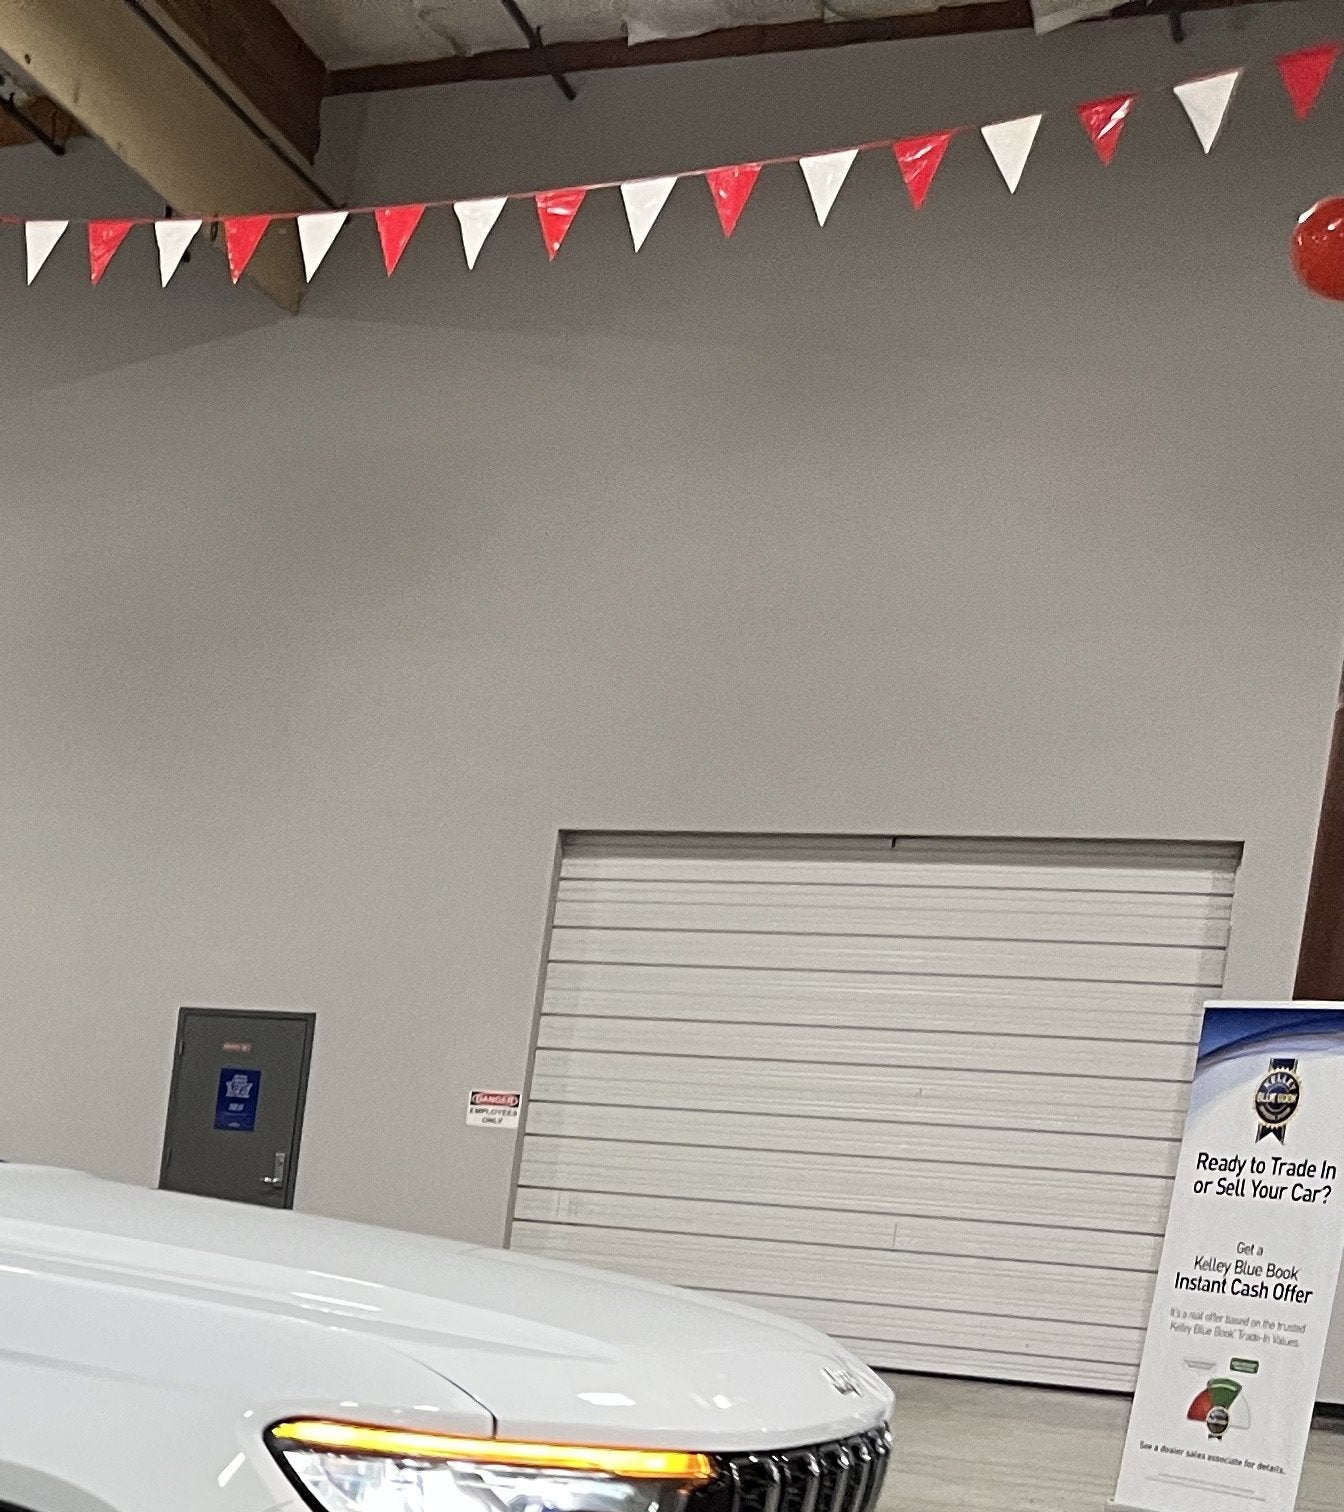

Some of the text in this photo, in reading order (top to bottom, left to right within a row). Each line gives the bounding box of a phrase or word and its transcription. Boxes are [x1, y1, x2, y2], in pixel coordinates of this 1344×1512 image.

[1196, 1152, 1337, 1180] Ready to Trade In
[1193, 1177, 1332, 1204] or Sell Your Car?
[1236, 1242, 1264, 1256] Get a
[1194, 1256, 1299, 1281] Kelley Blue Book
[1174, 1272, 1313, 1304] Instant Cash Offer
[1244, 1459, 1256, 1469] for
